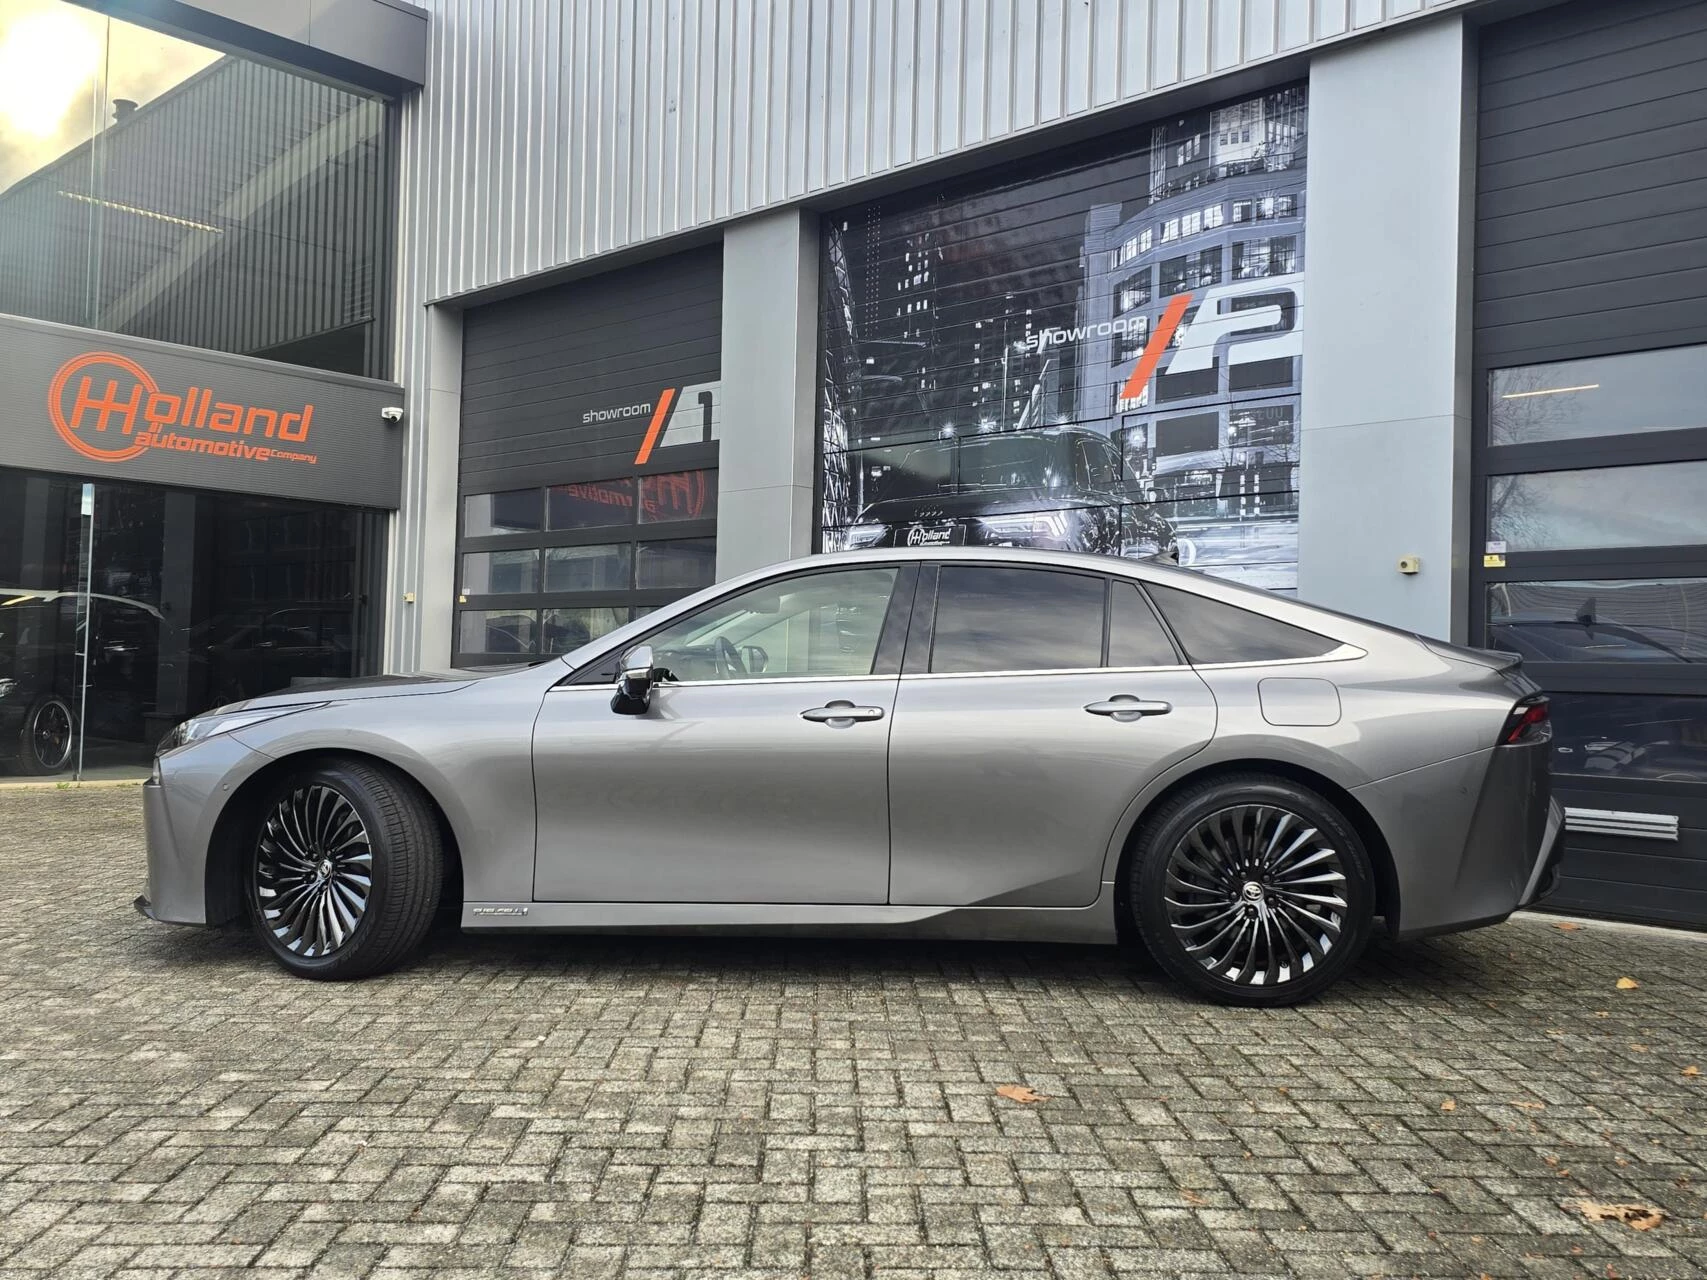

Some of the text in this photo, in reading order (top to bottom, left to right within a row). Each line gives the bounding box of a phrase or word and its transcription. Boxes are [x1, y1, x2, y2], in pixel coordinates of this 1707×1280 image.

[1025, 315, 1148, 351] showroom
[68, 373, 315, 443] Holland
[582, 402, 651, 424] showroom
[134, 431, 318, 465] automotive Company
